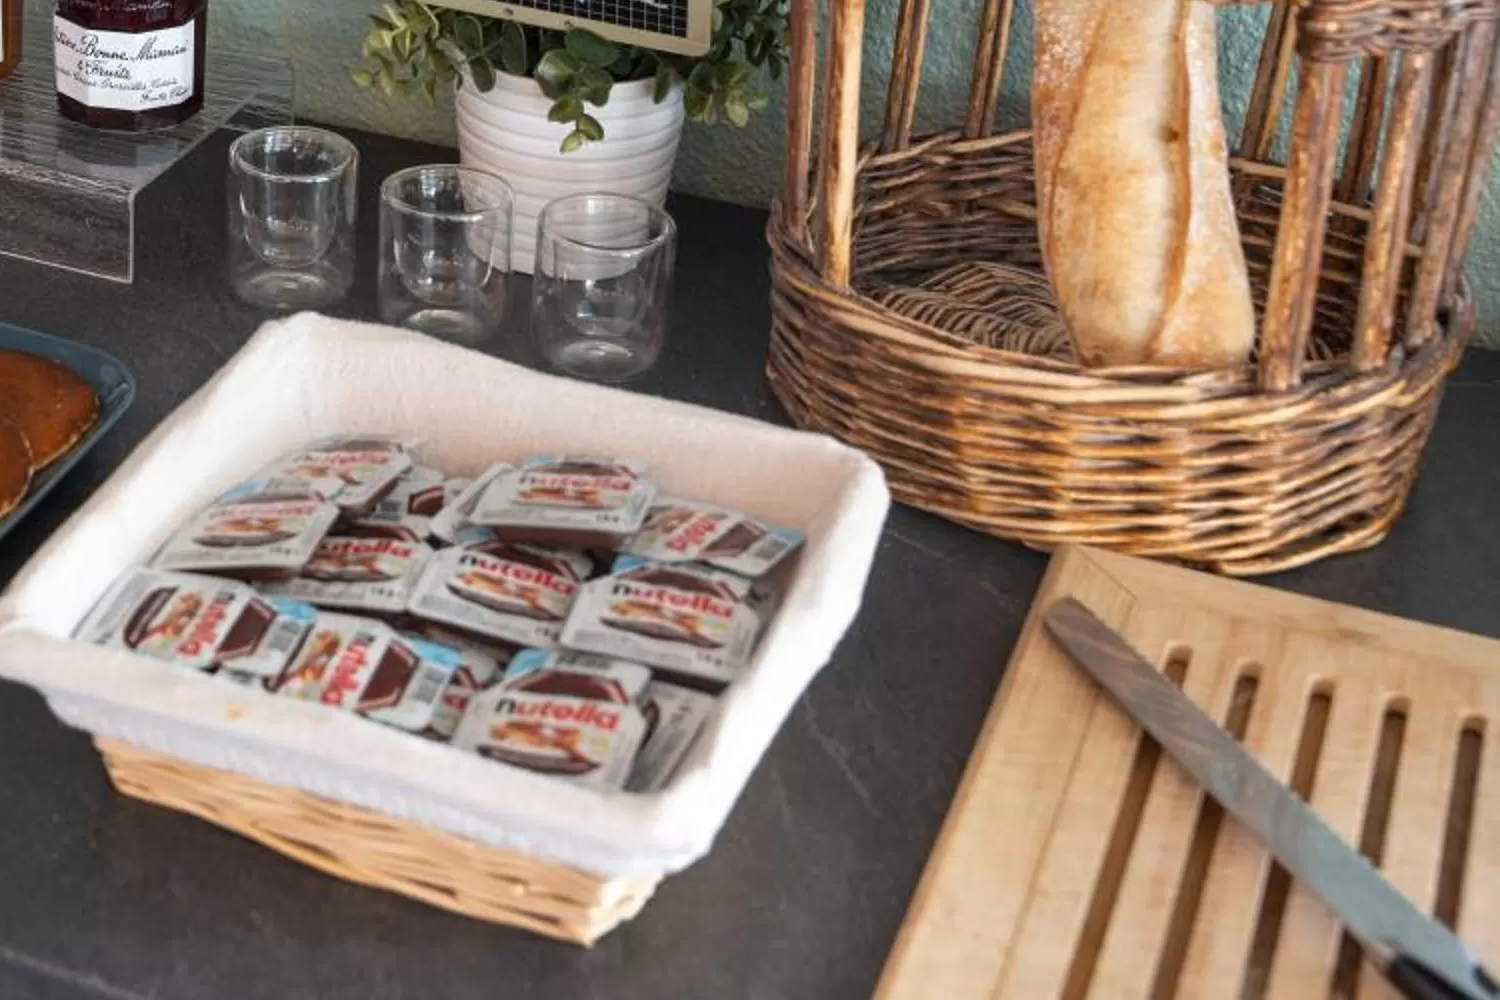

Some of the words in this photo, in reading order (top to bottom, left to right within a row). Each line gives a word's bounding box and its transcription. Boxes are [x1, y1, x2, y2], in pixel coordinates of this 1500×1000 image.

[459, 554, 574, 596] nutella
[612, 584, 734, 618] nutella
[494, 697, 621, 730] nutella
